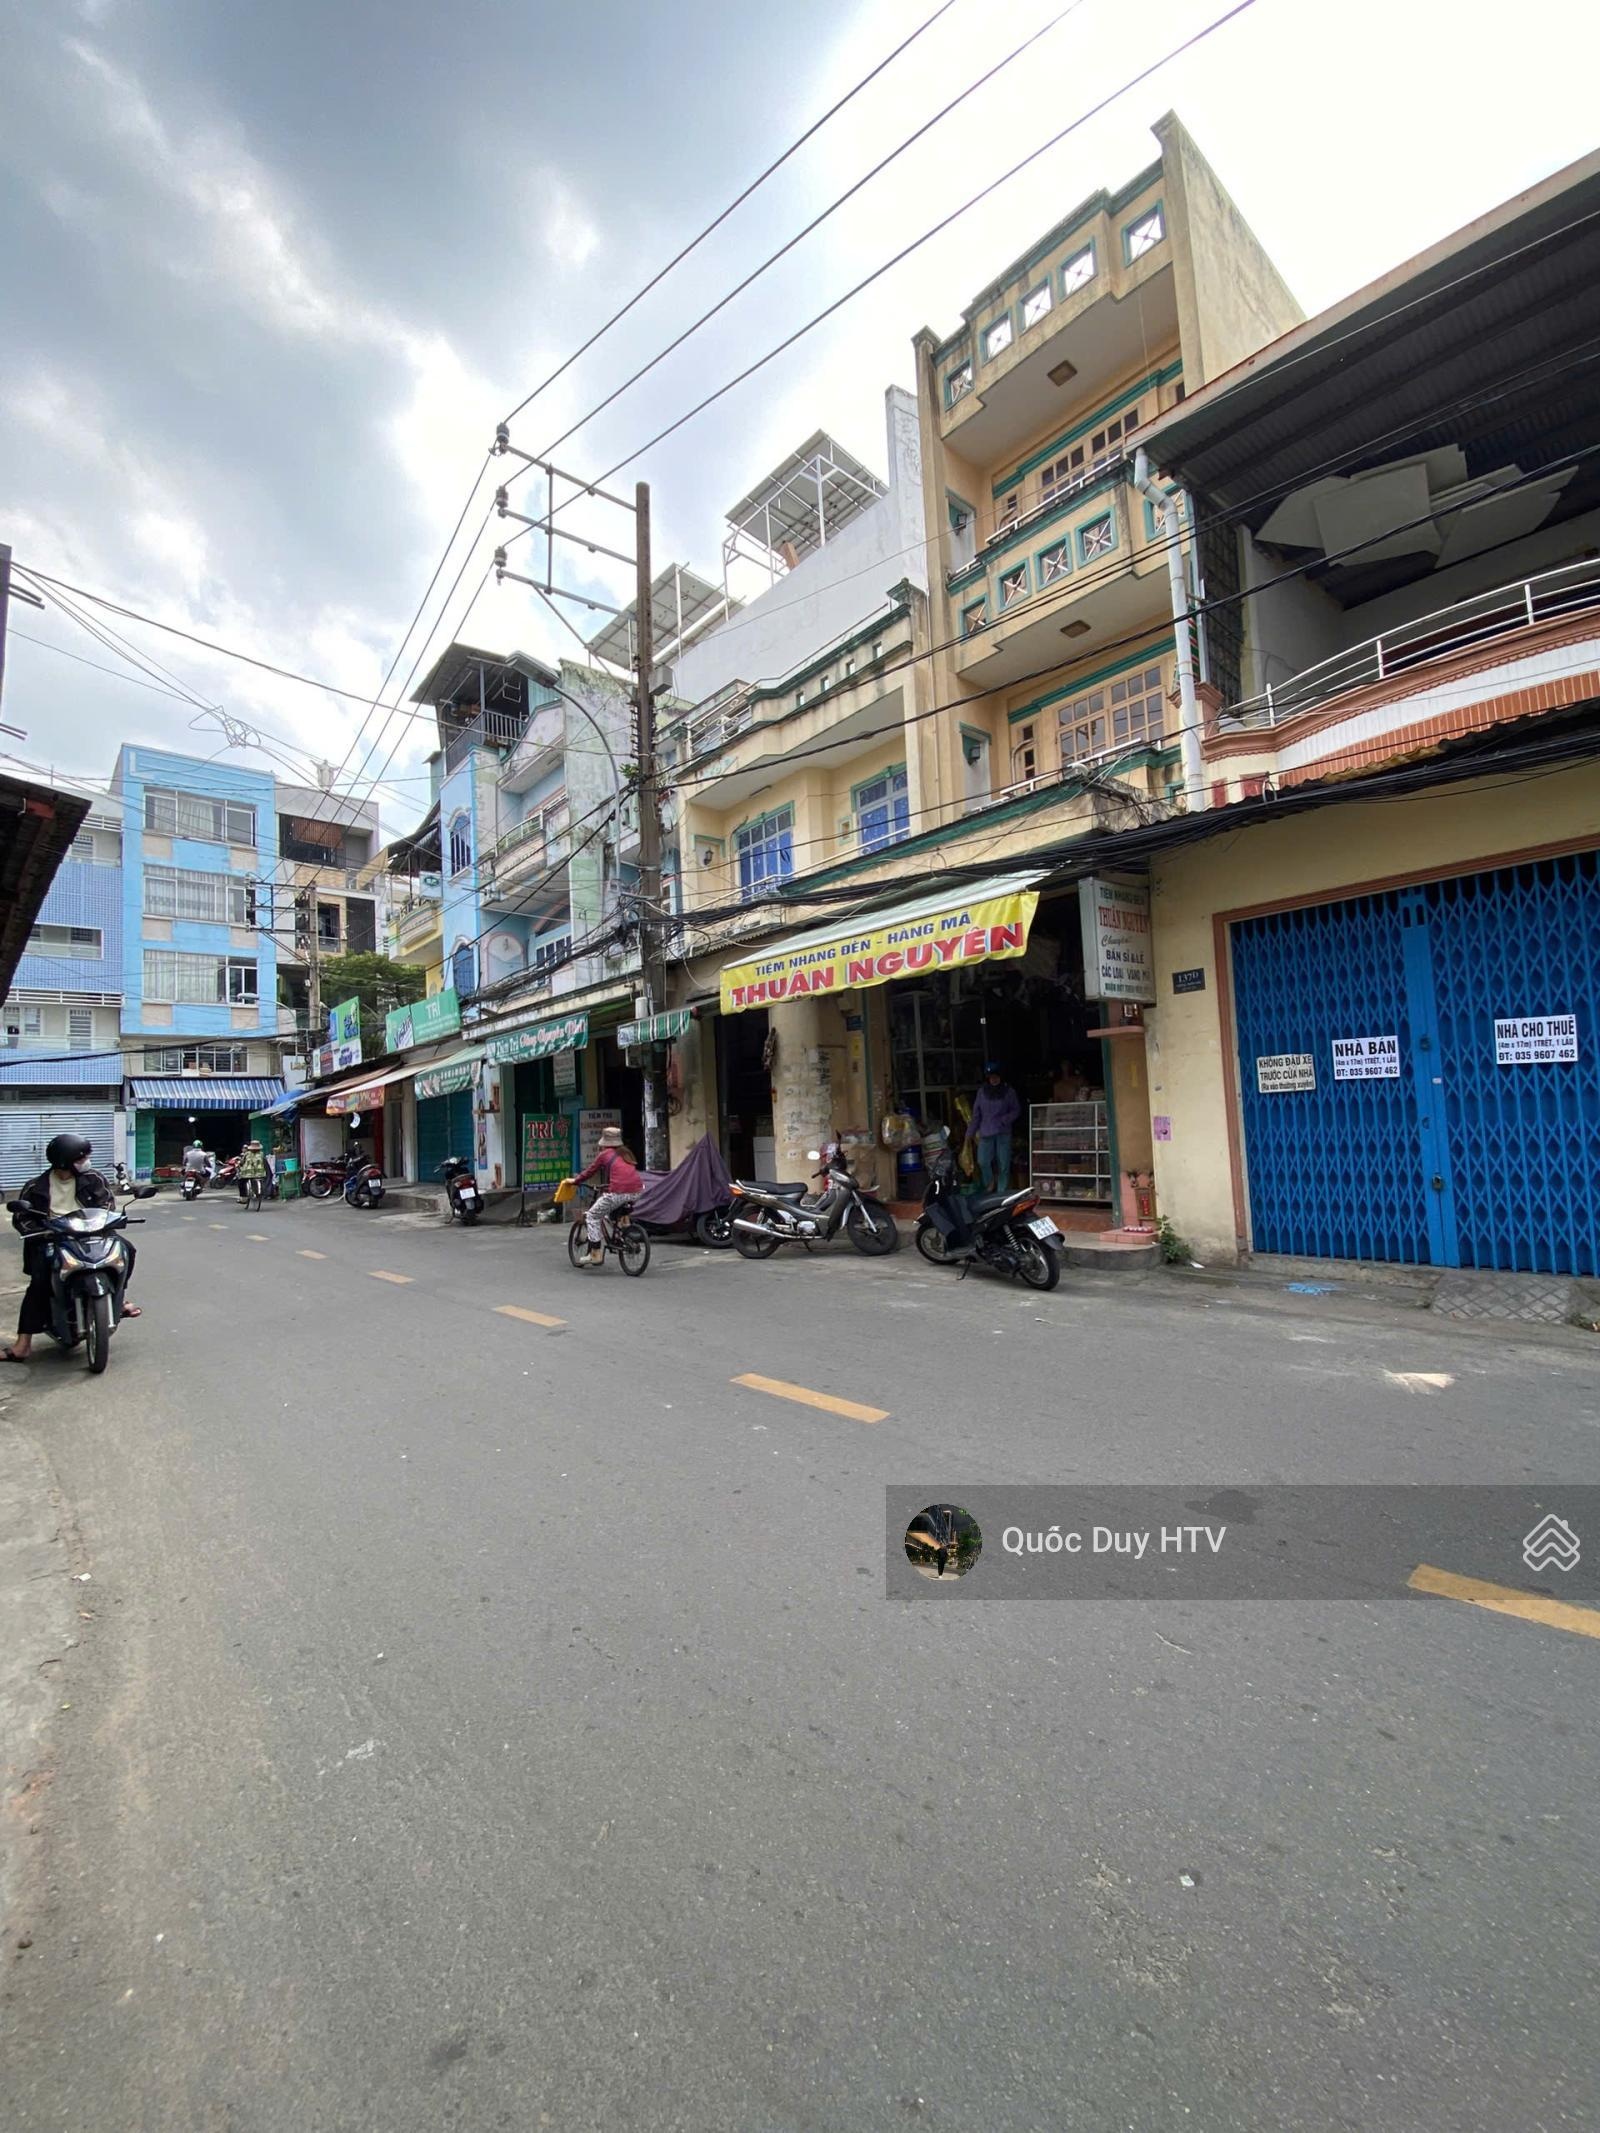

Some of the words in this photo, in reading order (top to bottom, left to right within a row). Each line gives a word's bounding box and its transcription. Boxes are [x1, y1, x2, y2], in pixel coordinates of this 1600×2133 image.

[755, 962, 785, 976] TIỆM
[789, 949, 836, 968] NHANG
[841, 940, 871, 956] ĐÈN
[887, 924, 934, 944] HÀNG
[941, 911, 971, 930] MÃ
[846, 921, 1025, 983] NGUYÊN
[1497, 1020, 1518, 1039] NHÀ
[1522, 1022, 1544, 1037] CHO
[1547, 1016, 1575, 1036] THUÊ
[1335, 1039, 1364, 1057] NHÀ
[1368, 1037, 1396, 1055] BÁN
[1517, 1040, 1532, 1049] 17m)
[1259, 1057, 1283, 1069] KHÔNG
[1303, 1055, 1312, 1065] XE
[1499, 1052, 1513, 1061] ĐT:
[1515, 1051, 1531, 1060] 035
[1534, 1050, 1556, 1060] 9607
[1559, 1049, 1575, 1058] 462
[1283, 1067, 1298, 1080] CỬA
[1336, 1068, 1349, 1077] ĐT:
[1350, 1067, 1363, 1076] 035
[1365, 1066, 1382, 1076] 9607
[1384, 1065, 1398, 1075] 462
